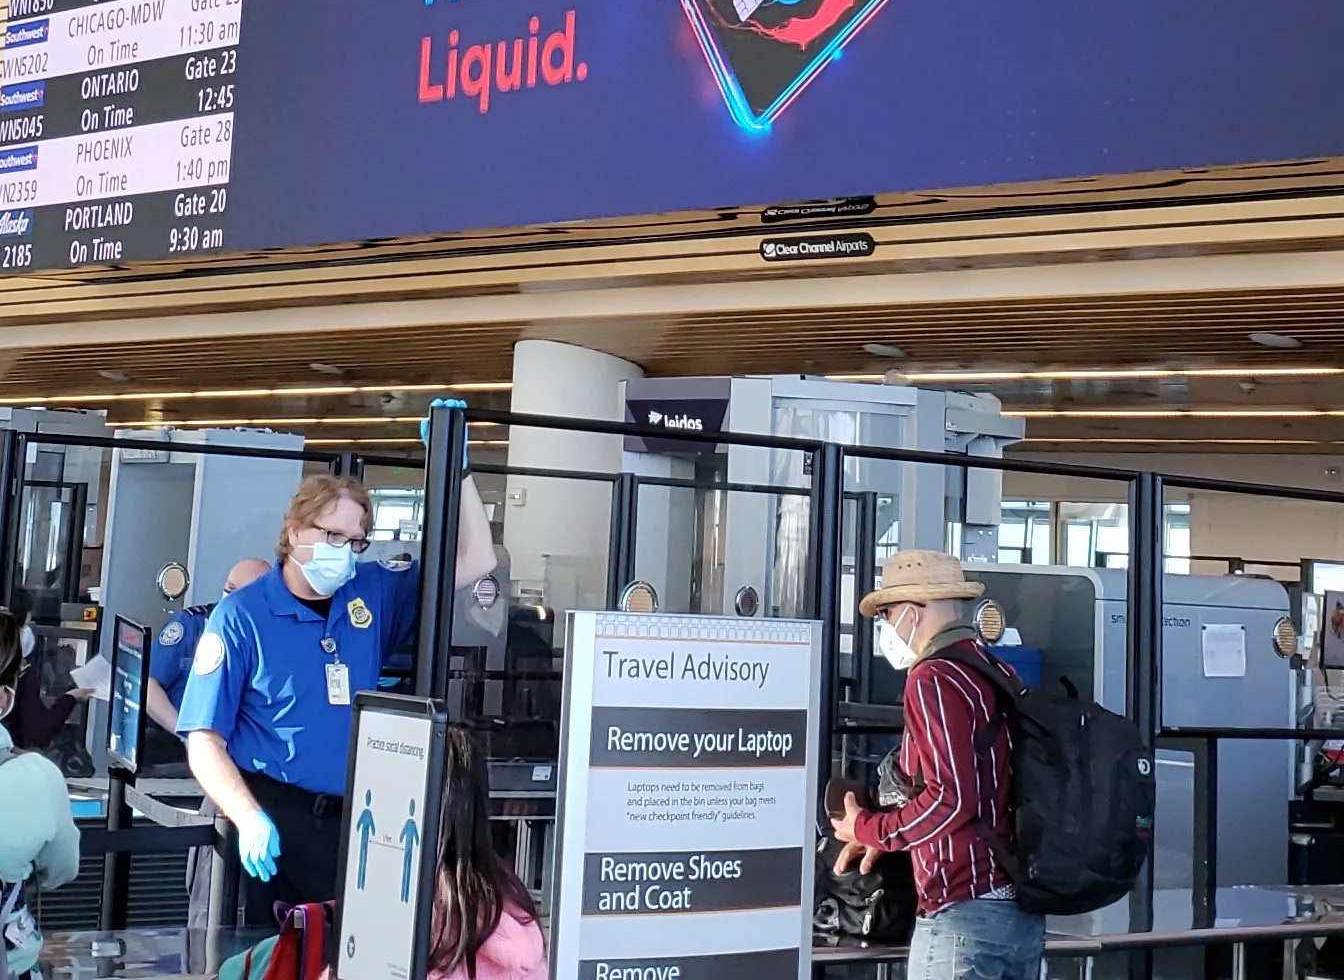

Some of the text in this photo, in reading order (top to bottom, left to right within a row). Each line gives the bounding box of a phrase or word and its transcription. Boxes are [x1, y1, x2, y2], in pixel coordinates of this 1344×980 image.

[68, 0, 166, 38] CHICAGO-MDW
[5, 26, 45, 44] Southwest
[179, 22, 239, 48] 11:30 am
[87, 39, 138, 65] On Time
[418, 10, 588, 114] Liquid.
[2, 52, 49, 79] WN5202
[185, 51, 237, 80] Gate 23
[81, 69, 139, 98] ONTARIO
[0, 90, 40, 107] Southwest
[197, 85, 234, 112] 12:45
[81, 106, 133, 131] On Time
[180, 119, 231, 148] Gate 28
[76, 137, 133, 164] PHOENIX
[176, 157, 228, 182] 1:40 pm
[76, 171, 128, 196] On Time
[175, 189, 226, 217] Gate 20
[65, 203, 133, 231] PORTLAND
[70, 239, 122, 263] On Time
[169, 229, 223, 253] 9:30 am
[776, 240, 868, 255] Clear Channel Airports
[2, 244, 32, 267] 2185
[602, 650, 769, 688] Travel Advisory
[607, 726, 793, 757] Remove your Laptop
[628, 782, 660, 793] Laptops
[661, 782, 680, 791] need
[691, 782, 700, 791] be
[702, 782, 731, 791] removed
[734, 781, 748, 790] from
[750, 781, 764, 792] bags
[601, 855, 743, 881] Remove Shoes
[598, 885, 692, 910] and Coat
[595, 963, 680, 980] Remove
